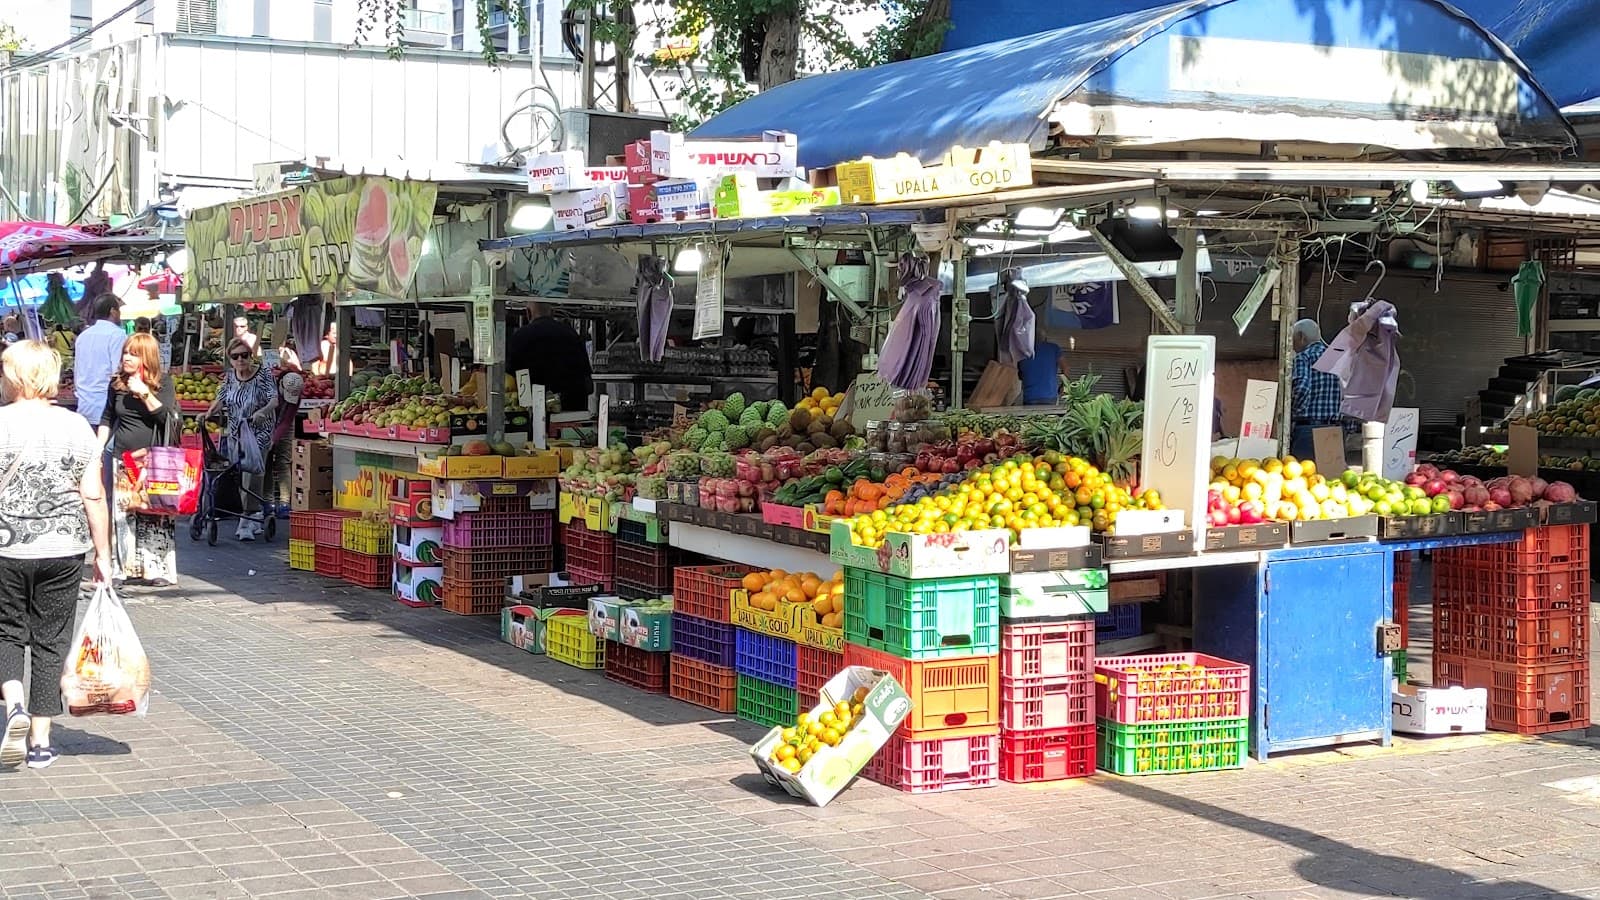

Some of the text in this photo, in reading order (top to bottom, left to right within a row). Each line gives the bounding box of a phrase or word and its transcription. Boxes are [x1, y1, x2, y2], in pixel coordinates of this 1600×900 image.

[688, 152, 781, 165] בראשיתי
[528, 166, 565, 178] בראשיתי
[895, 169, 1012, 195] UPALA GOLD
[229, 195, 301, 246] אבטיח
[202, 241, 351, 293] ירוק אדום מתוק טרי
[1252, 387, 1273, 410] 5
[738, 609, 790, 635] UPALA GOLD
[804, 627, 824, 646] UPALA
